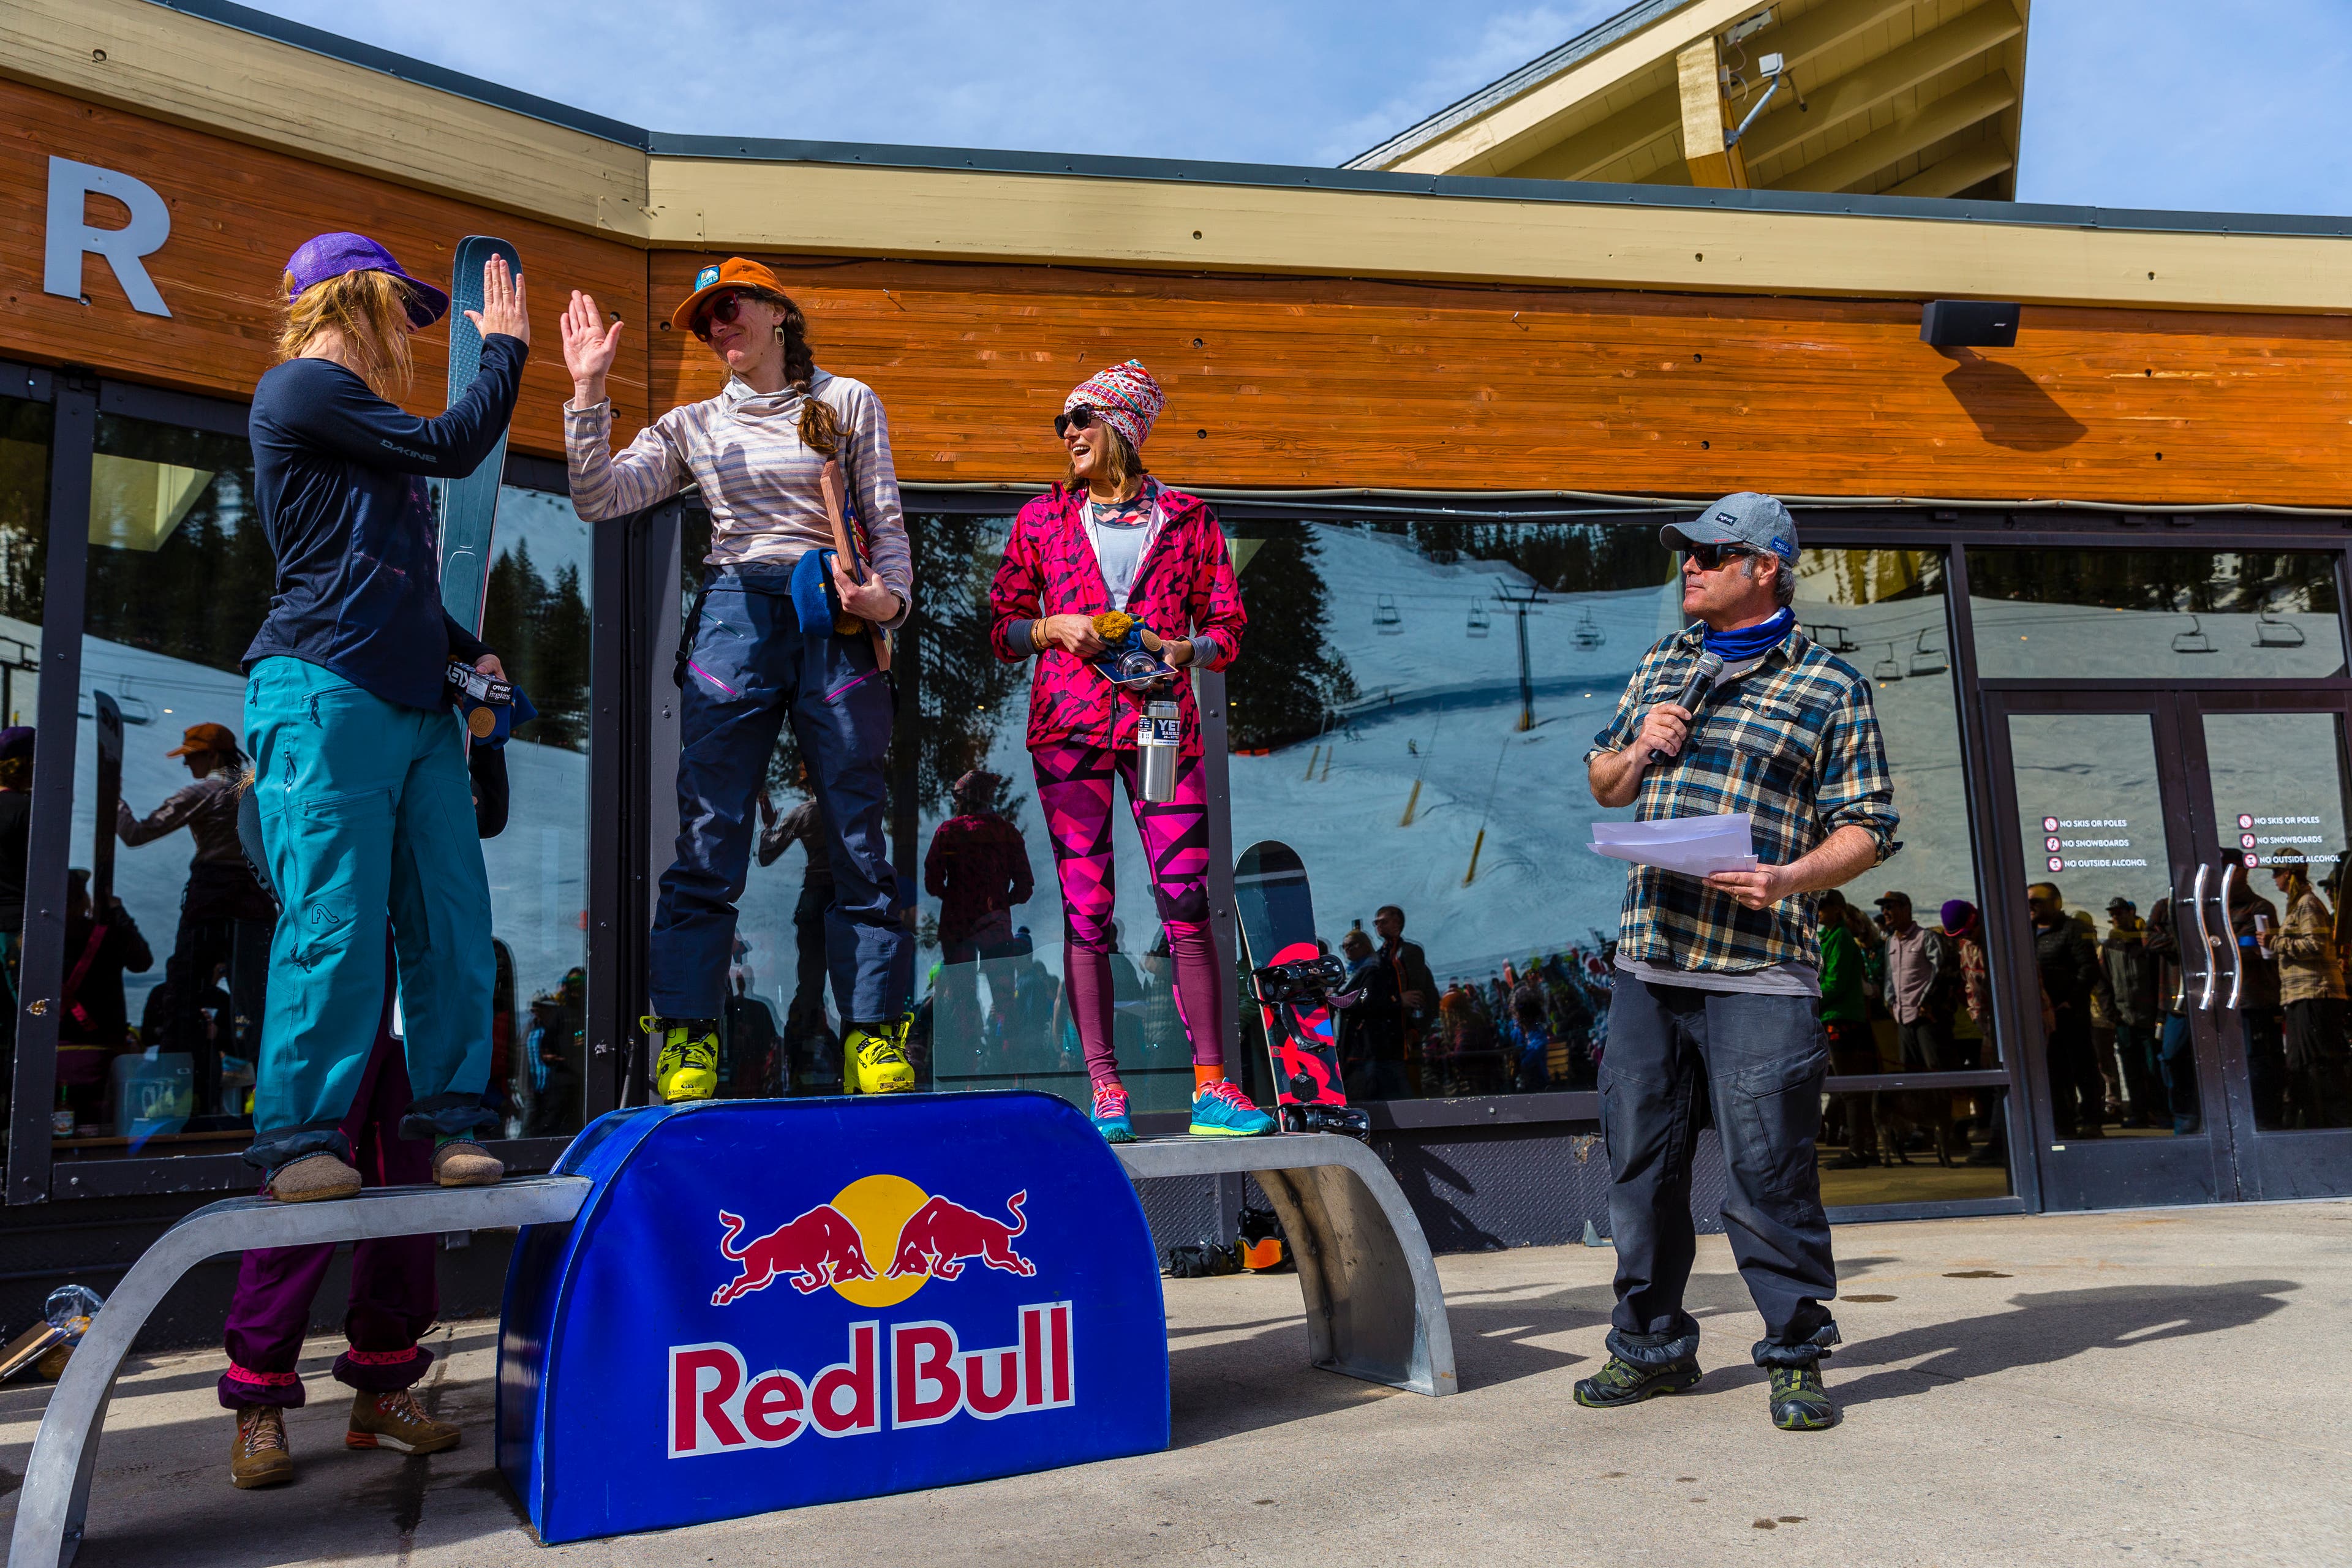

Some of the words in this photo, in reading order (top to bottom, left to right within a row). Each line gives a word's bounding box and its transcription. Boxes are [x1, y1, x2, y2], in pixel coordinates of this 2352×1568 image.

[43, 154, 173, 318] R
[380, 439, 438, 462] DAKINE
[2272, 855, 2305, 864] OUTSIDE
[668, 1320, 881, 1459] Red
[891, 1300, 1076, 1430] Bull
